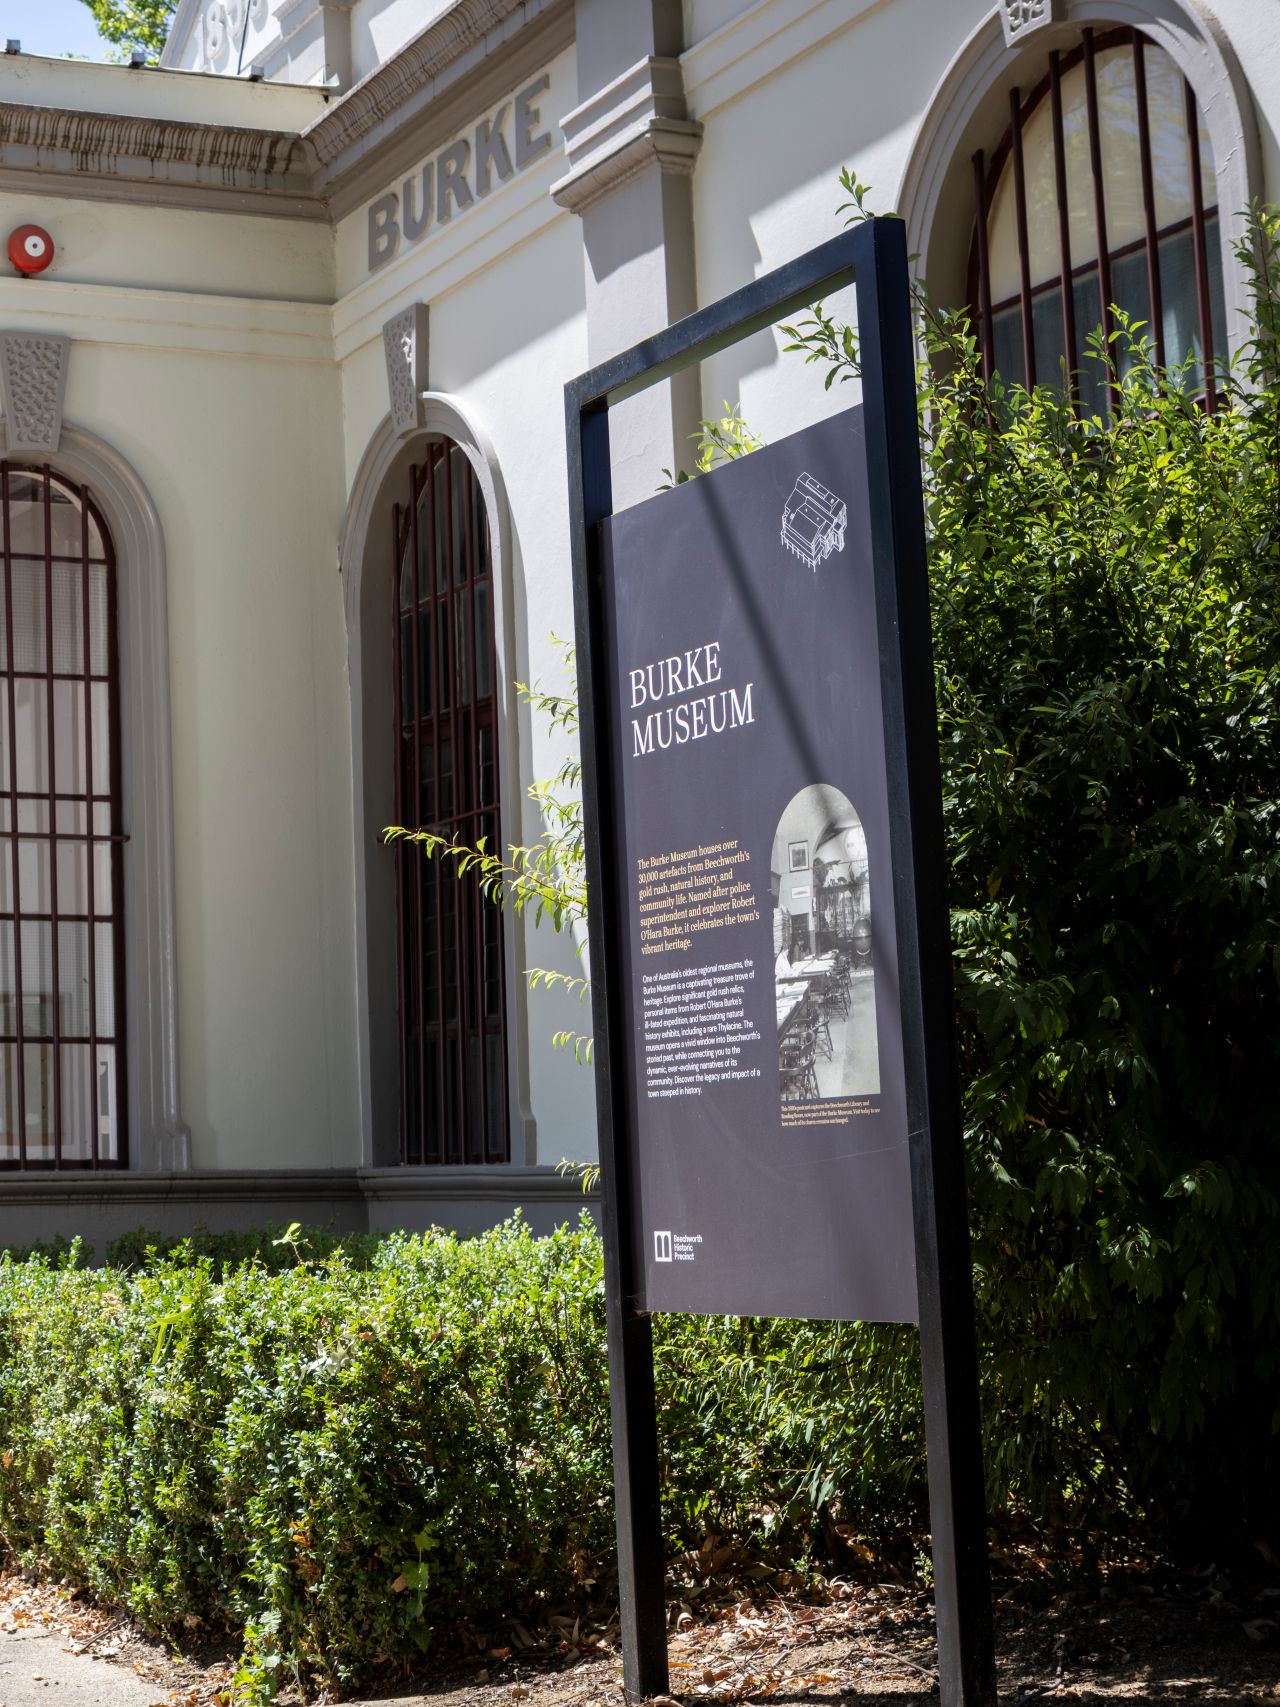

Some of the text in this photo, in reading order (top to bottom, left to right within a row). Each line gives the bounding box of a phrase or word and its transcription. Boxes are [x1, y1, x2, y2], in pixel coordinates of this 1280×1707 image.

[368, 73, 551, 273] BURKE
[629, 641, 722, 709] BURKE
[631, 682, 756, 758] MUSEUM
[638, 840, 738, 870] The Burke Museum houses over
[638, 851, 750, 884] 30,000 artefacts from Beechworth's
[639, 886, 652, 900] gold
[670, 877, 693, 891] natural
[720, 869, 733, 882] and
[640, 897, 675, 912] community
[688, 888, 712, 902] Named
[712, 886, 729, 898] after
[730, 882, 751, 897] police
[640, 895, 755, 928] superintendent and explorer Robert
[641, 929, 662, 940] O'Hara
[685, 922, 690, 932] it
[690, 917, 724, 931] celebrates
[725, 914, 736, 925] the
[737, 910, 760, 923] town's
[641, 941, 664, 955] vibrant
[673, 1234, 702, 1242] Beechworth
[674, 1244, 693, 1252] Historic
[674, 1252, 694, 1260] Precinct
